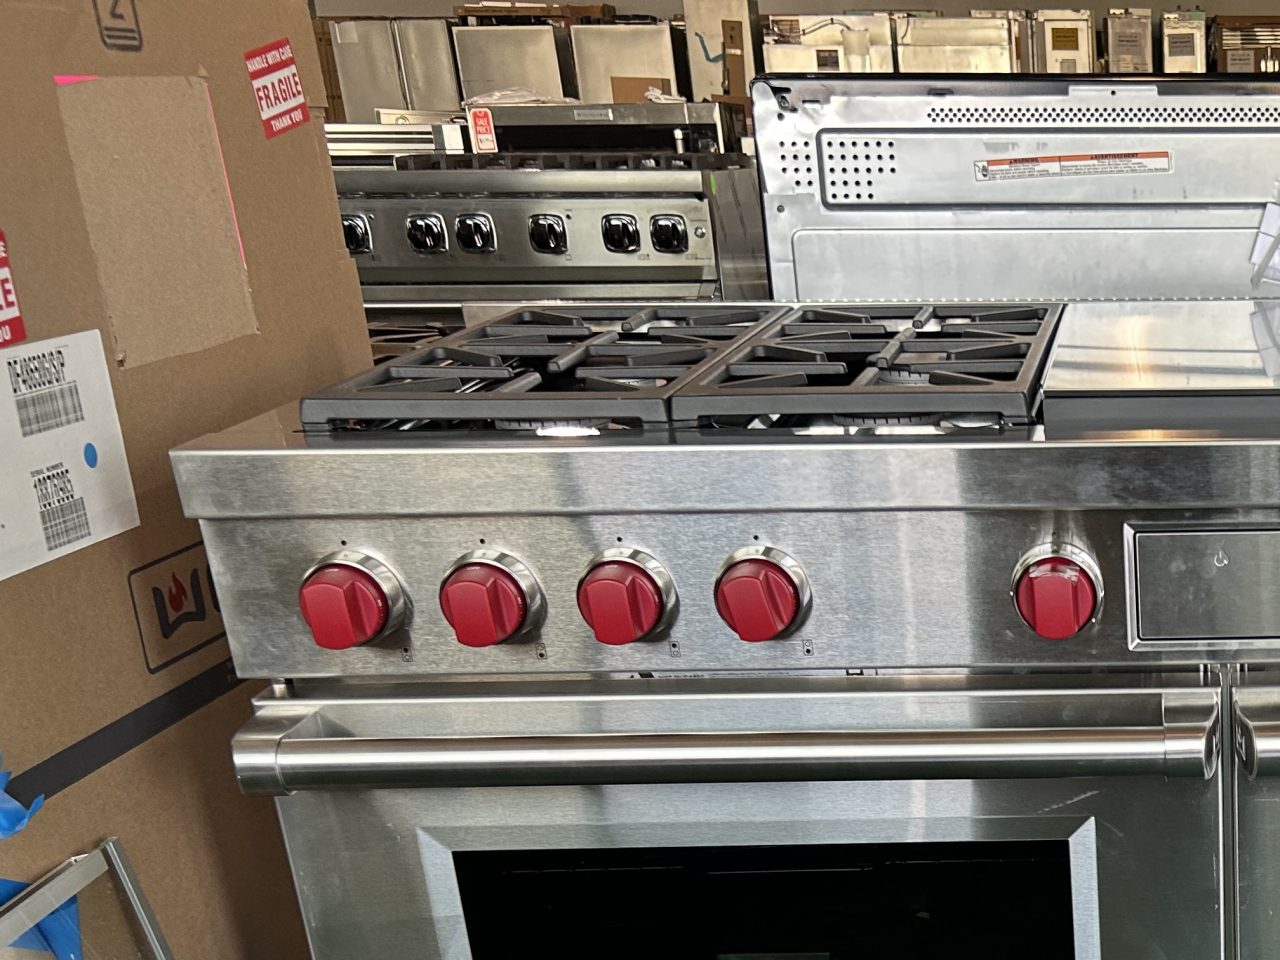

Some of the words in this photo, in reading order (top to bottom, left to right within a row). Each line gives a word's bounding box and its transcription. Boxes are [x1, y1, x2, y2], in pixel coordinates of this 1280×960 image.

[245, 54, 269, 72] HANDLE
[267, 49, 281, 65] WITH
[280, 45, 293, 60] CARE
[256, 73, 302, 111] FRAGILE
[271, 113, 292, 132] THANK
[291, 108, 303, 124] YOU
